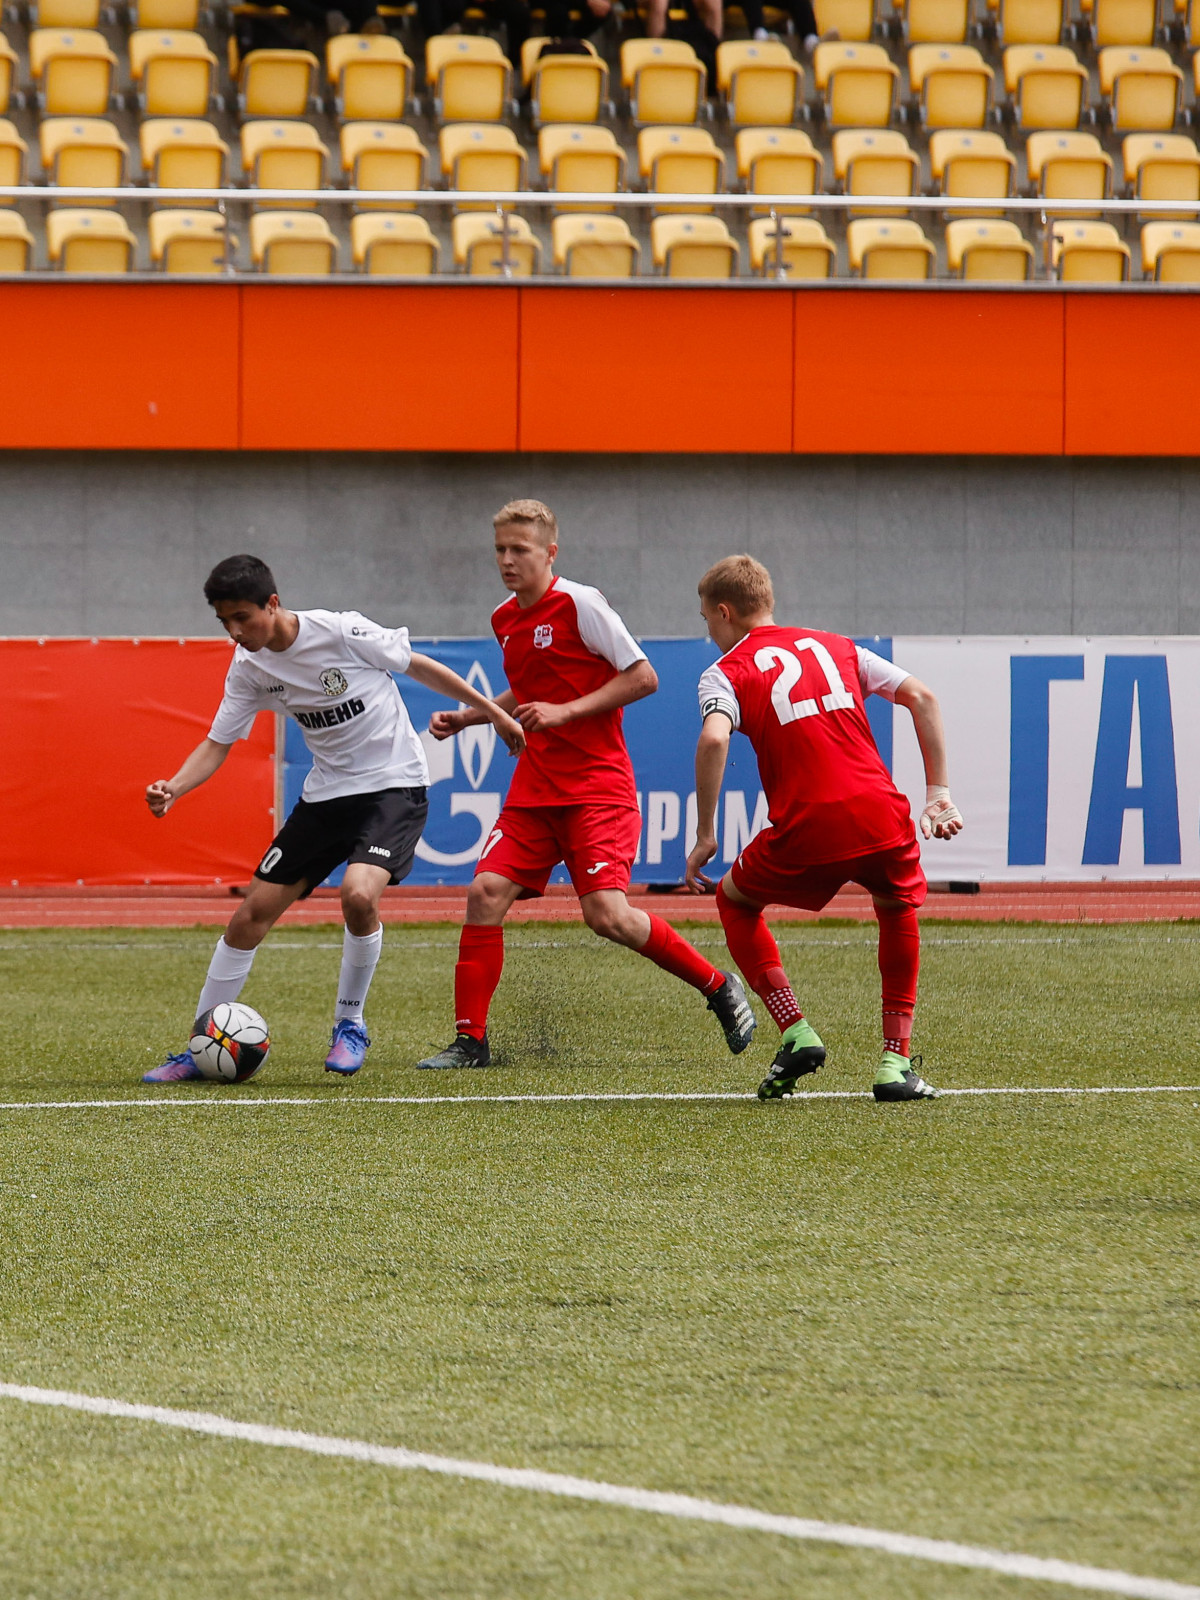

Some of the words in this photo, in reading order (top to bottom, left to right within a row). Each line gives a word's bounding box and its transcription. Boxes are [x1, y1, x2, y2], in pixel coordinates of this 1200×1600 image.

[754, 637, 855, 726] 21
[1007, 655, 1182, 866] ГА
[368, 845, 391, 858] JAKO
[633, 790, 774, 865] РОМ
[338, 998, 360, 1007] JAKO
